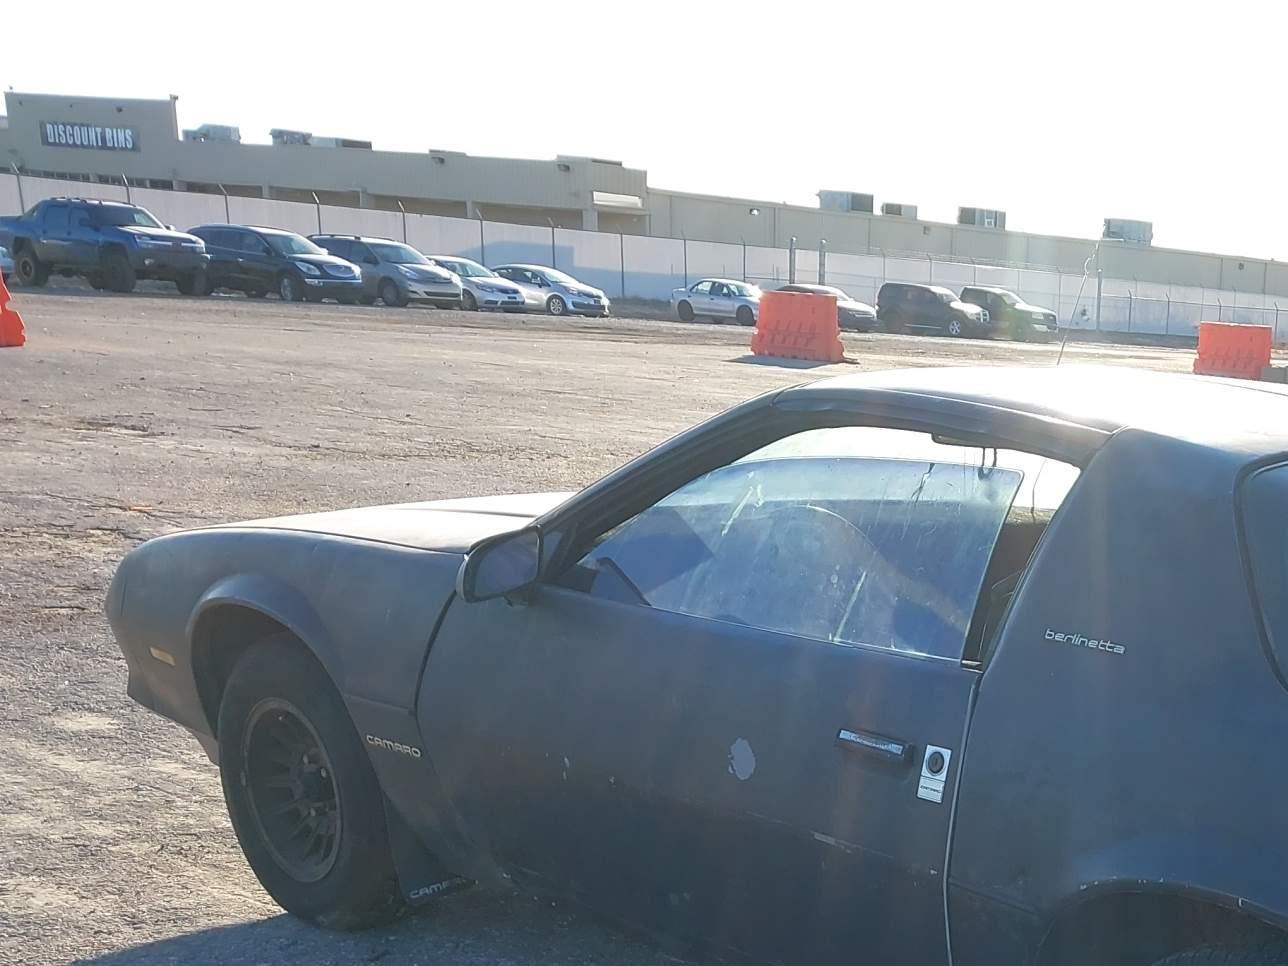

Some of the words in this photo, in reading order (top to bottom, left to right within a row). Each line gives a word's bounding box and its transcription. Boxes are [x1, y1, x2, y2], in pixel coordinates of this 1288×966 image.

[46, 123, 102, 146] DISCOUNT
[105, 127, 133, 149] BINS
[1044, 627, 1126, 654] berlinetta
[366, 735, 421, 757] CAMARO
